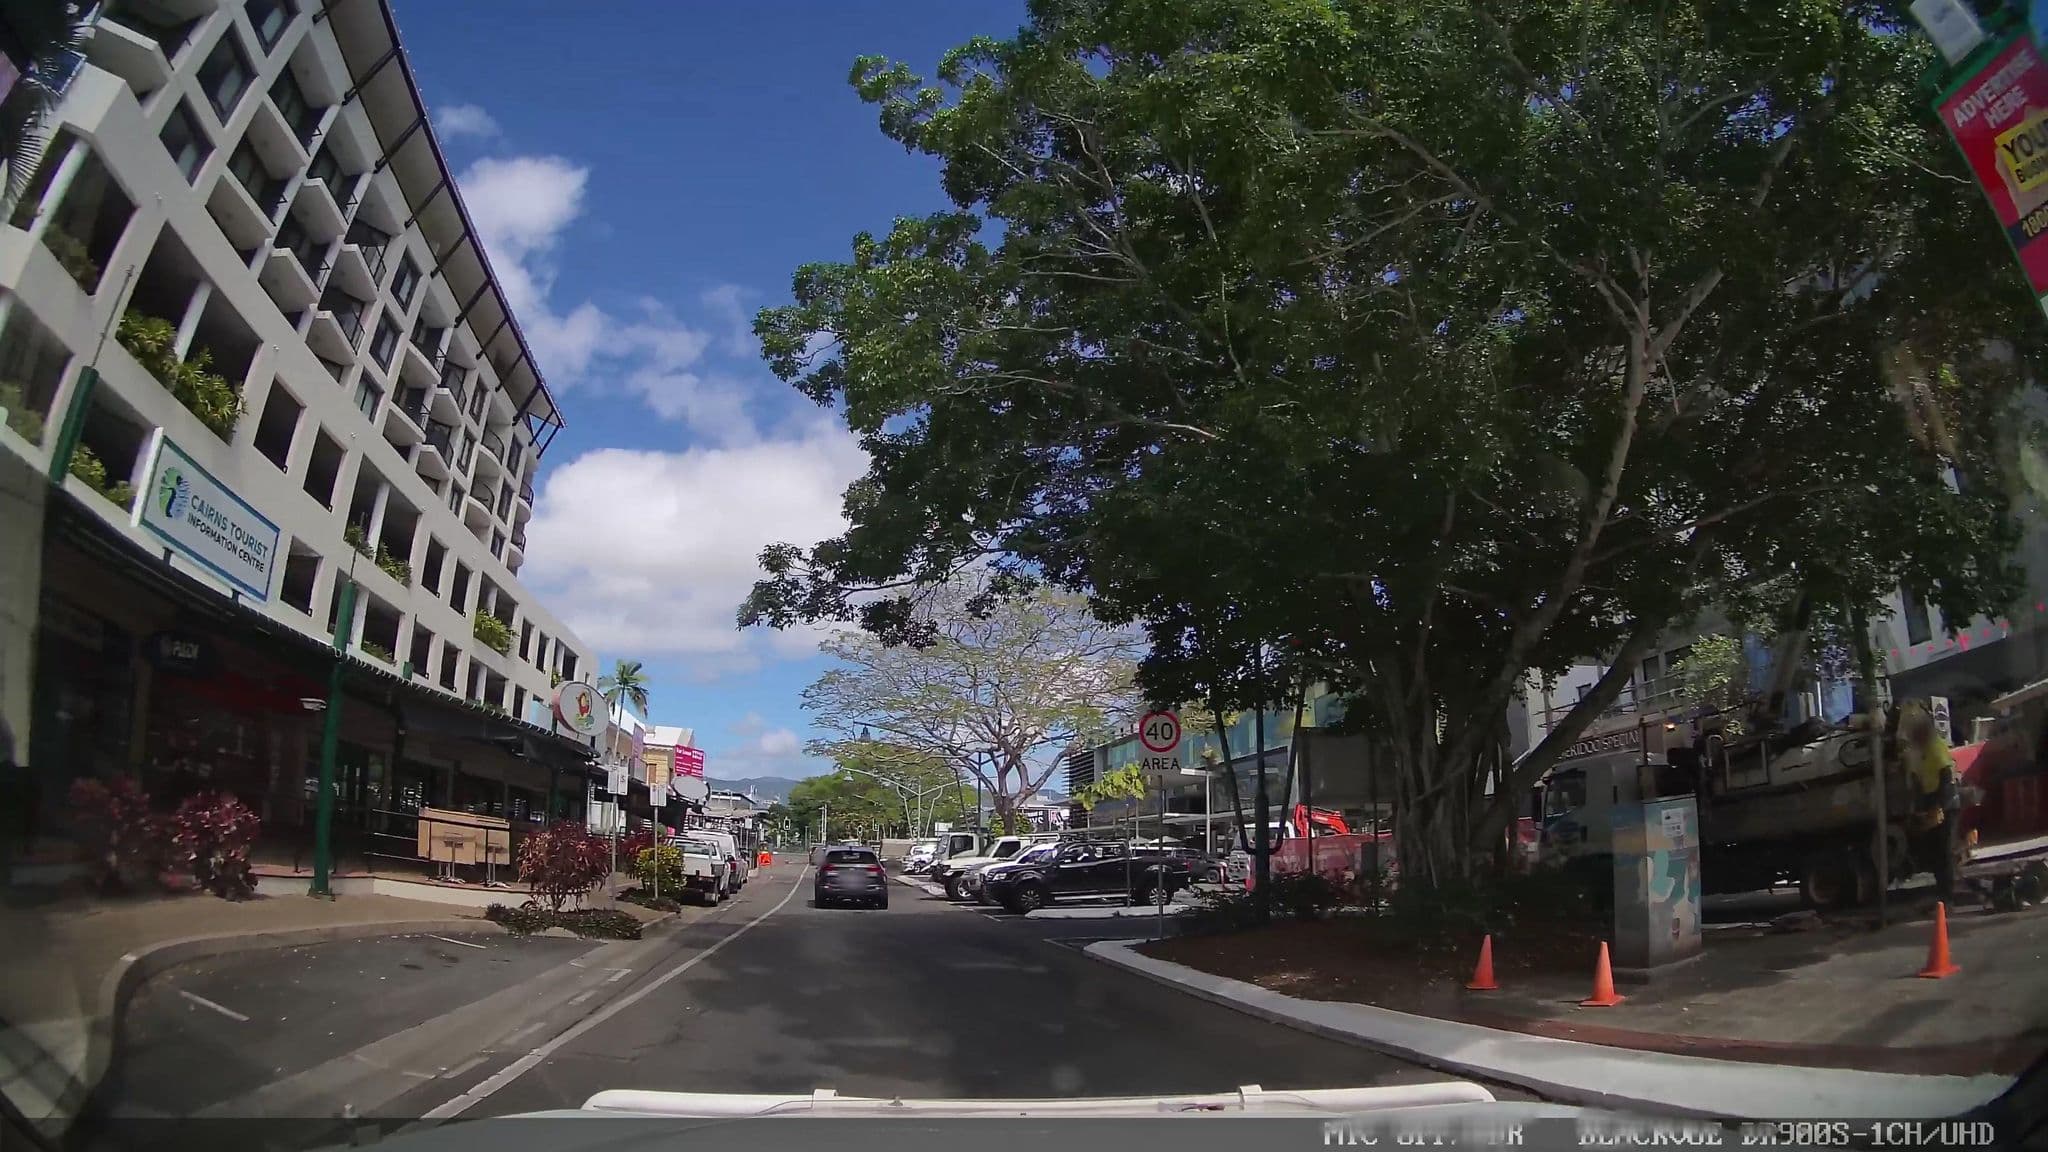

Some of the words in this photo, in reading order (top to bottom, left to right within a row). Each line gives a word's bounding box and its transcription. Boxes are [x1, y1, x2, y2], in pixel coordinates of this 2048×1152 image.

[187, 512, 238, 555] INFORMATION
[238, 548, 265, 573] CENTRE
[190, 495, 228, 531] CAIRNS
[230, 522, 268, 558] TOURIST
[1146, 722, 1173, 740] 40
[1142, 757, 1180, 770] AREA
